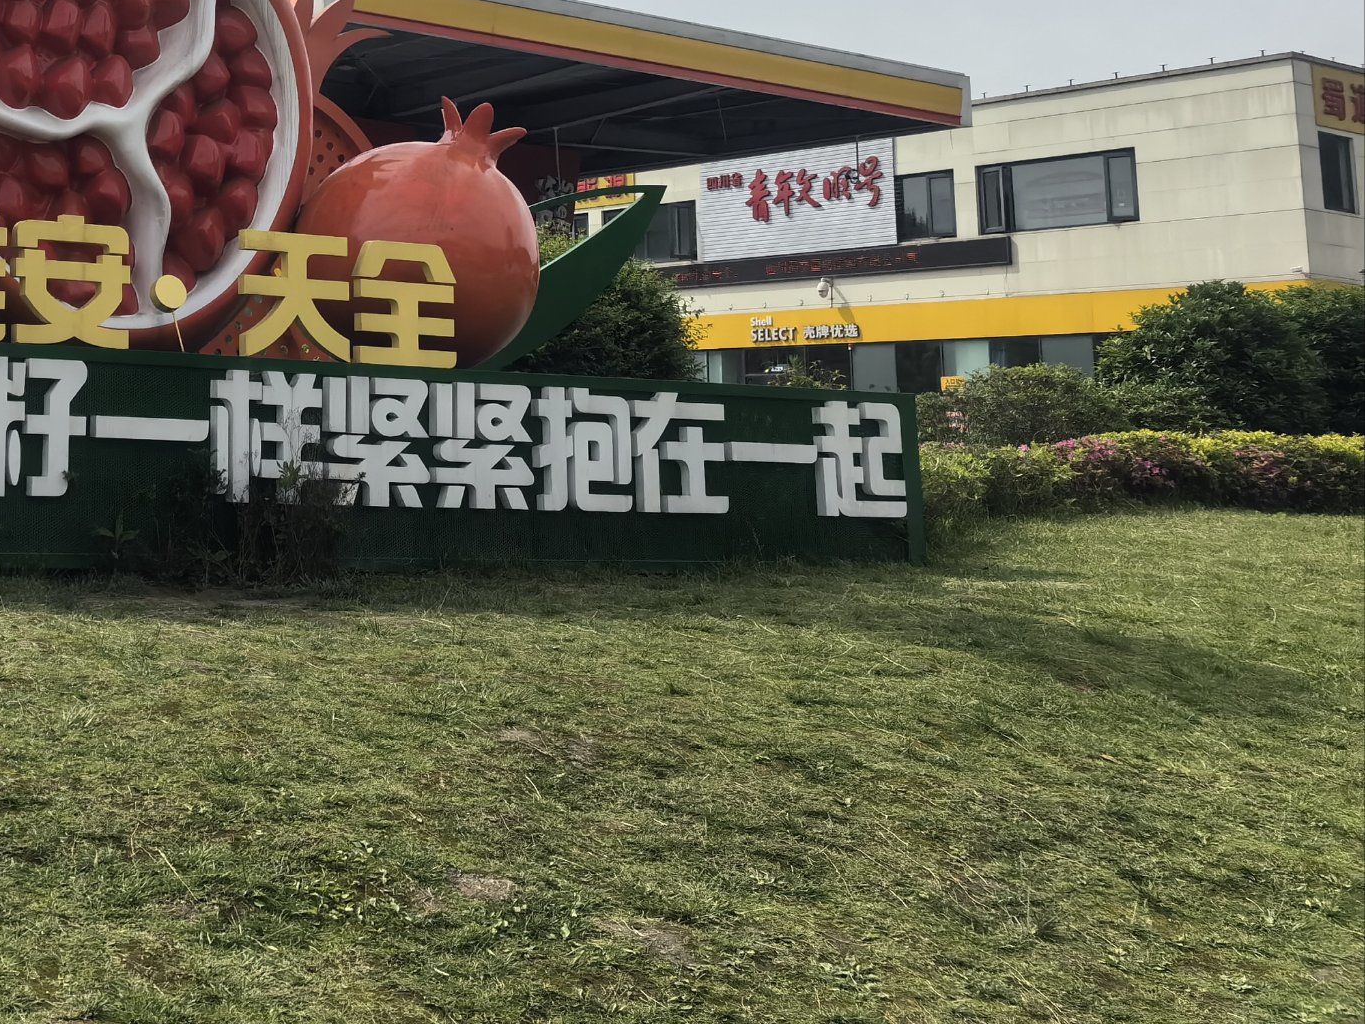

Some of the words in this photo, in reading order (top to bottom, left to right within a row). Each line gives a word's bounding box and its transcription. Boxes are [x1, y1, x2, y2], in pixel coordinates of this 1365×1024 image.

[707, 172, 743, 190] 四川省
[745, 156, 883, 223] 青年文明号
[750, 316, 773, 327] Shell
[751, 327, 796, 342] SELECT
[803, 323, 860, 339] 壳牌优选
